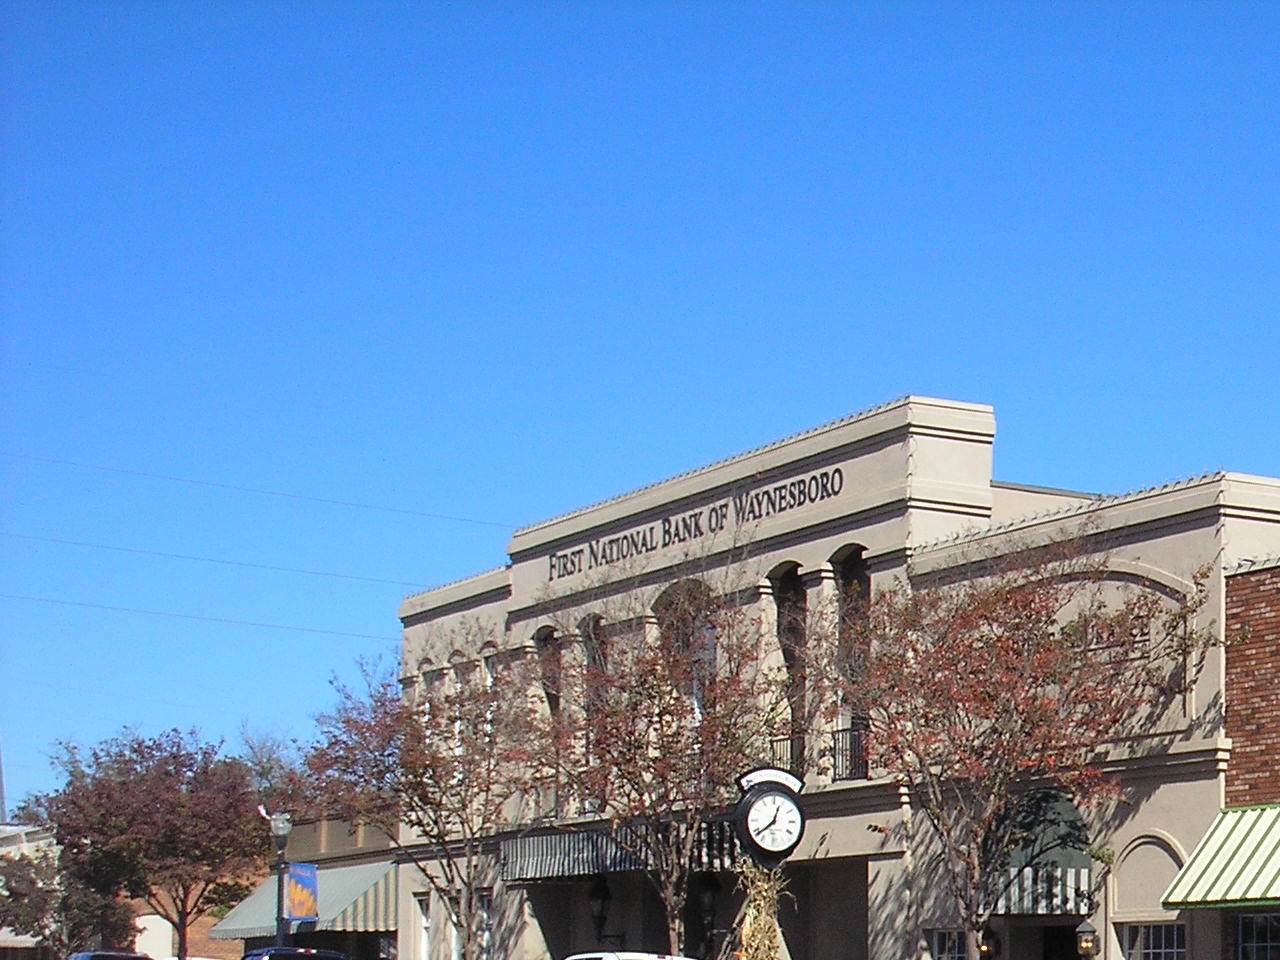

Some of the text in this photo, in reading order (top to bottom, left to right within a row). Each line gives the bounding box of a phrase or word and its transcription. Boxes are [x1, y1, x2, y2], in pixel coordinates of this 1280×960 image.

[549, 467, 844, 580] FIRST NATIONAL BANK OF WAYNESBORO
